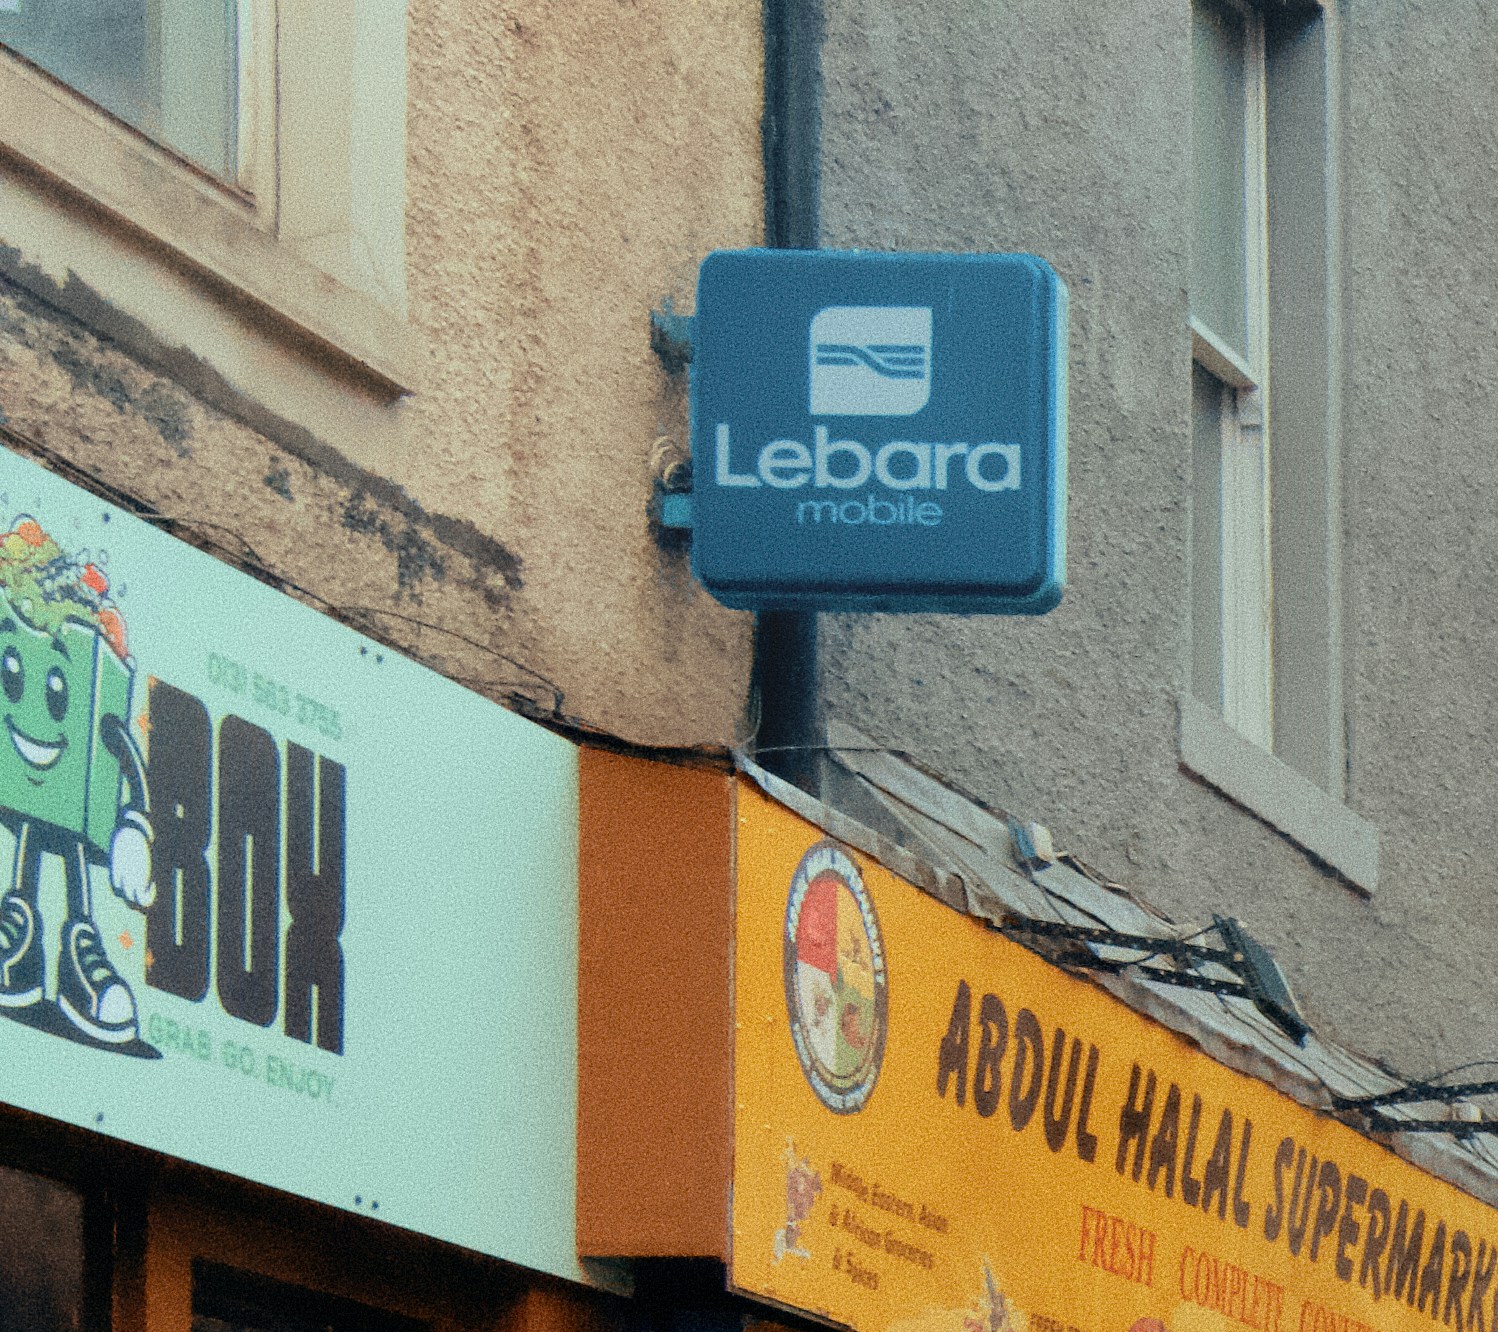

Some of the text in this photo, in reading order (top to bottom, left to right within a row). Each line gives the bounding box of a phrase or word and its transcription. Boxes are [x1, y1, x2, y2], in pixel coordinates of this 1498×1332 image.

[715, 423, 1022, 492] Lebara
[797, 495, 943, 526] mobile
[144, 674, 346, 1057] BOX
[265, 1054, 336, 1100] ENJOY
[936, 978, 1100, 1165] ABDUL
[1115, 1060, 1252, 1229] HALAL
[846, 1251, 879, 1291] Spices
[1079, 1204, 1156, 1288] FRESH
